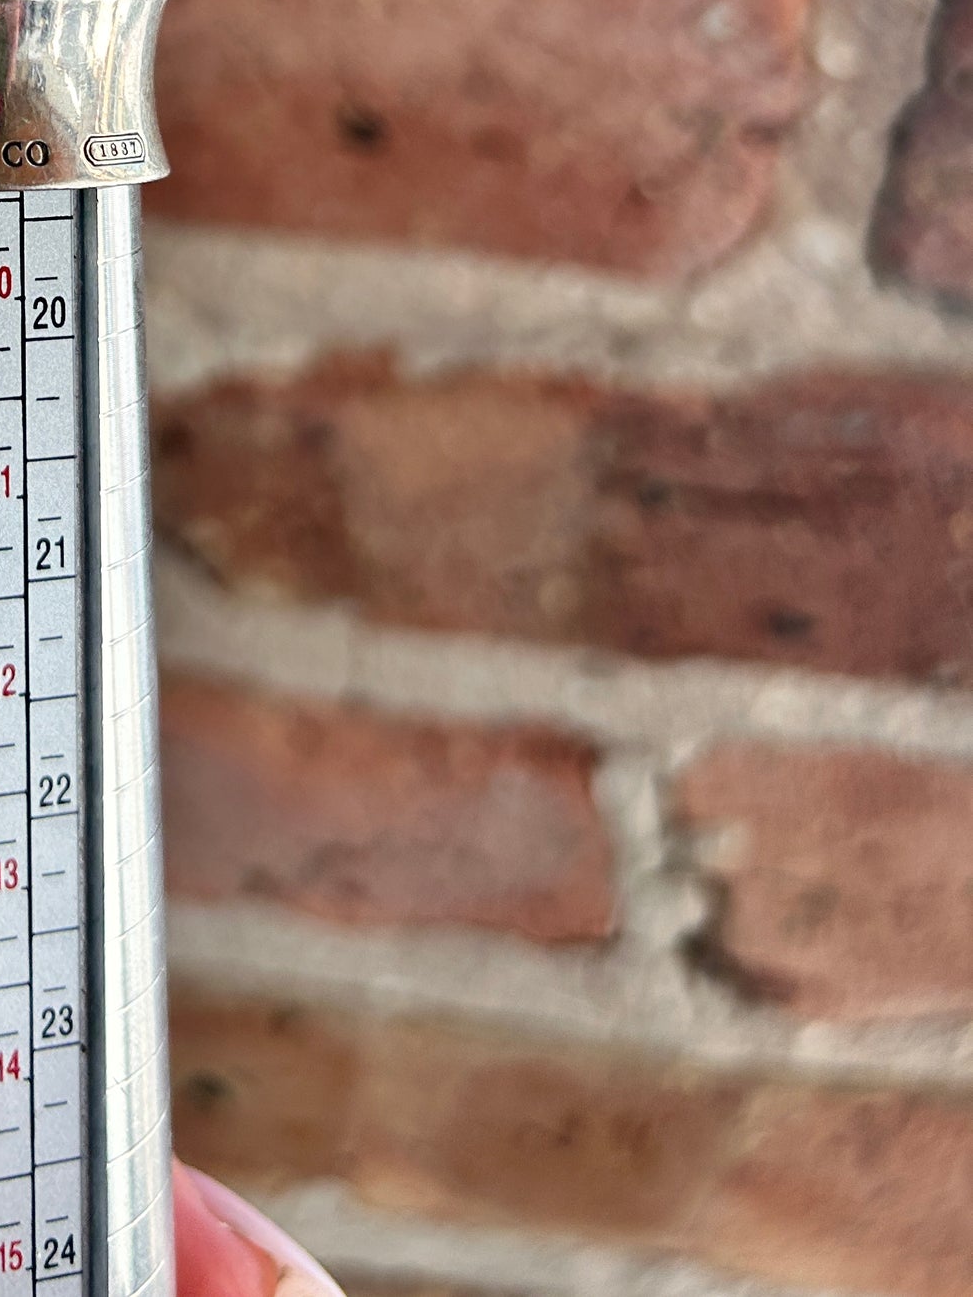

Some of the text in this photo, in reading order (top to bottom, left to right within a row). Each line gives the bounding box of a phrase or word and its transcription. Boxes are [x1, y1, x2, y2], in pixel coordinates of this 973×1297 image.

[99, 141, 137, 158] 1837
[32, 295, 66, 330] 20
[36, 535, 65, 571] 21
[39, 774, 71, 808] 22
[41, 1005, 74, 1039] 23
[43, 1233, 76, 1270] 24
